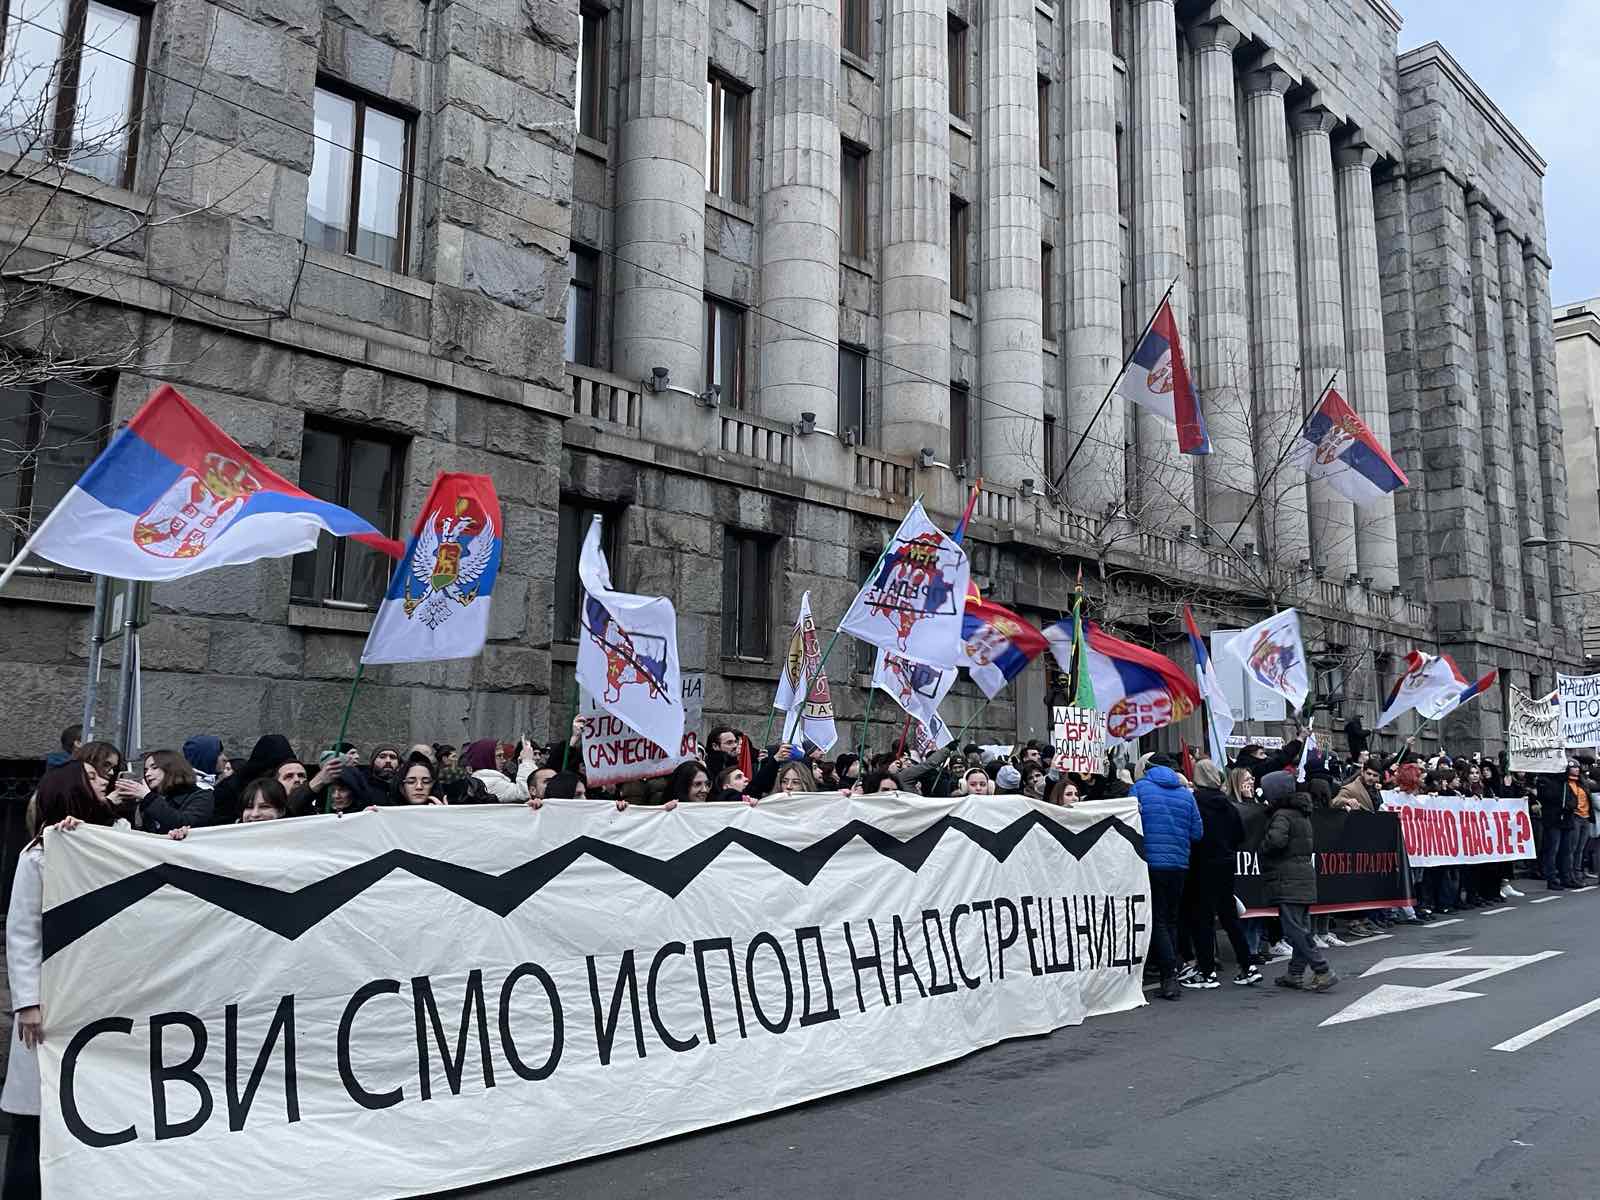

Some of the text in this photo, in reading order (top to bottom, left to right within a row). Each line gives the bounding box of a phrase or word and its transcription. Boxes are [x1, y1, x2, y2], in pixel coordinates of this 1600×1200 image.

[1566, 698, 1600, 718] ПРО
[1388, 805, 1458, 857] ОЛИКО
[1459, 810, 1493, 856] НАС
[59, 894, 1146, 1148] СВИ СМО ИСПОД НАДСТРЕШНИЦЕ
